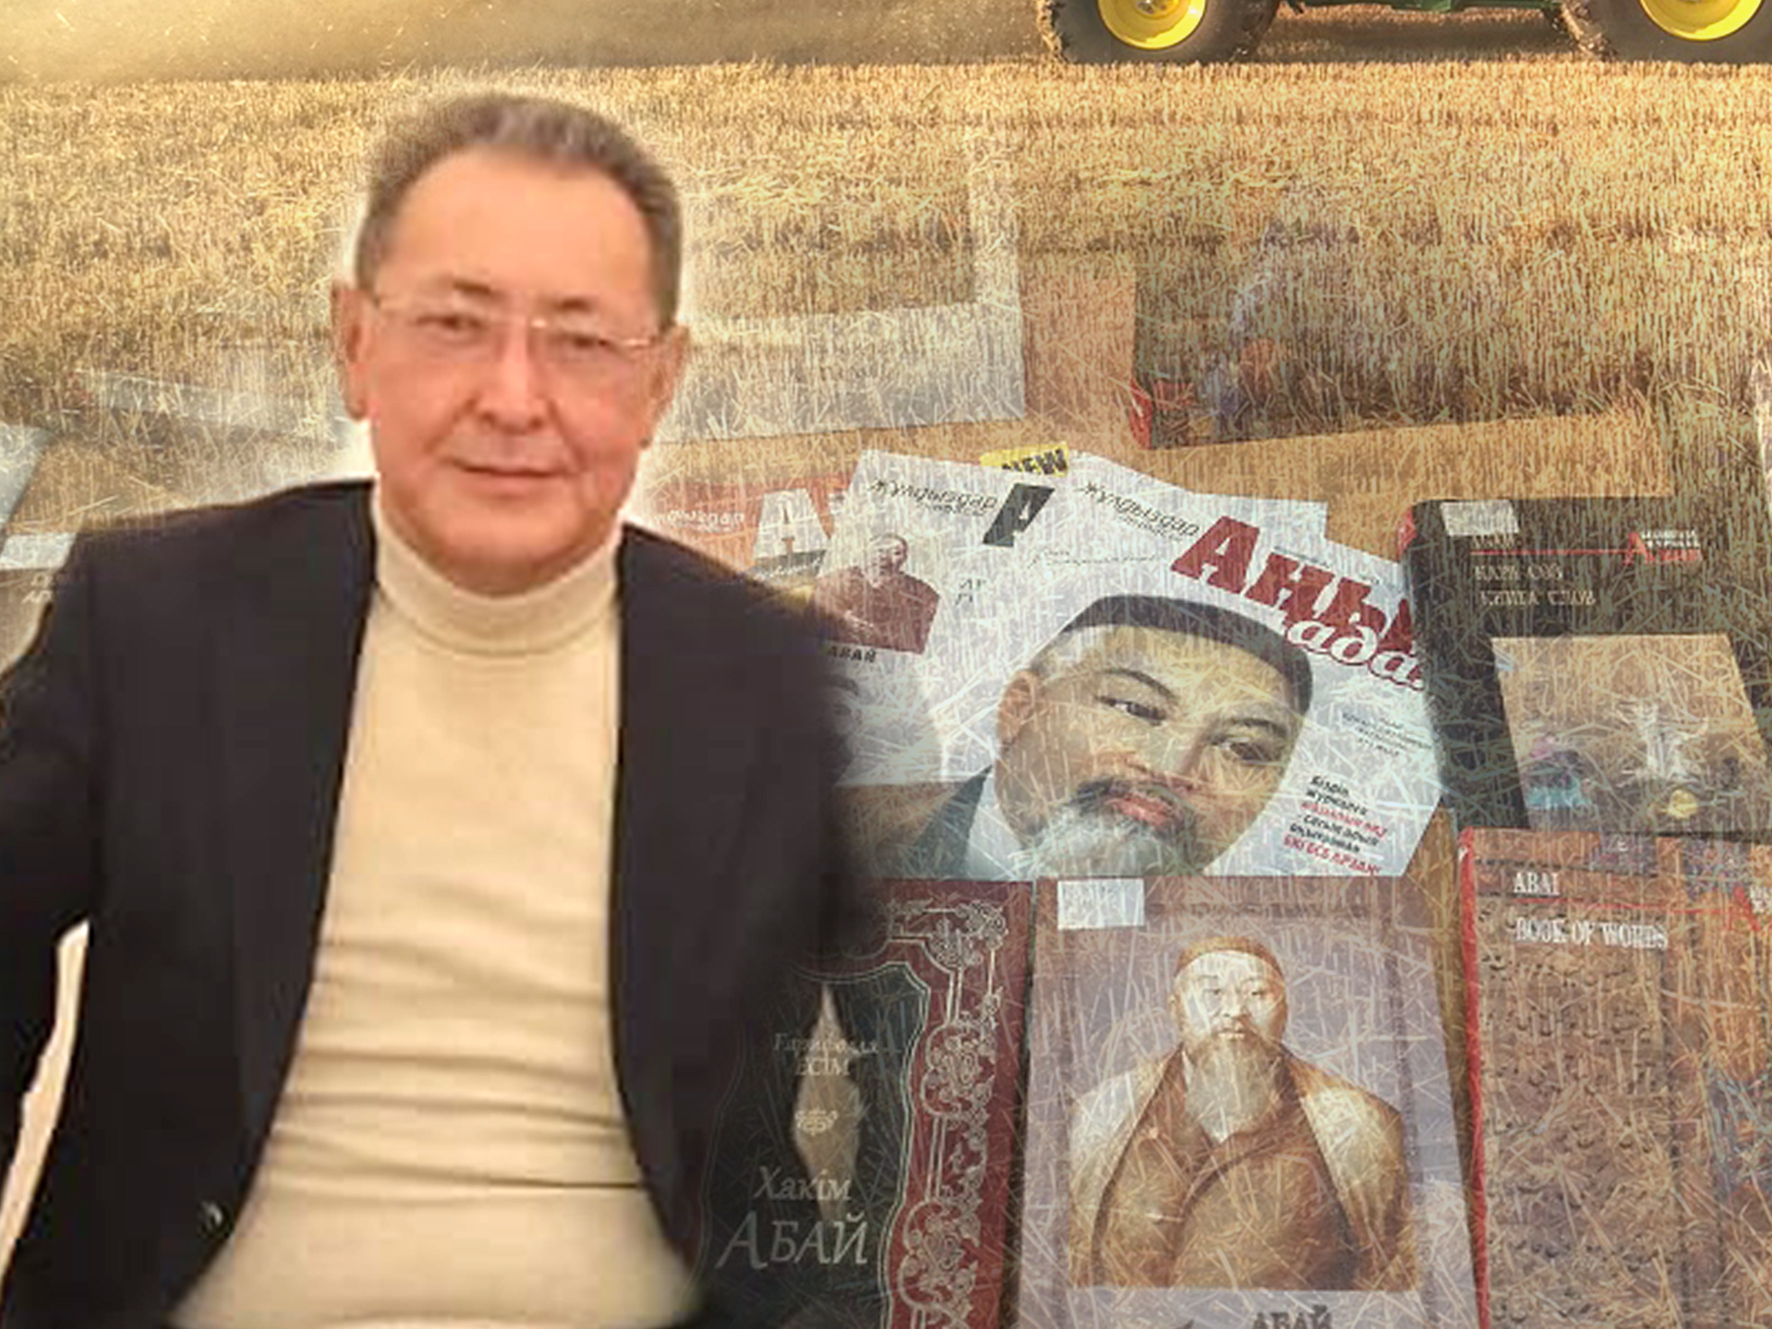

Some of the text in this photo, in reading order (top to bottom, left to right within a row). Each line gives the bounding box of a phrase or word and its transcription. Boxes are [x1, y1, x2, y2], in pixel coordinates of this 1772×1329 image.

[1513, 871, 1561, 896] ABAI
[1515, 917, 1568, 944] BOOK
[1600, 922, 1669, 950] WORDS
[752, 1165, 854, 1202] Хакім
[714, 1209, 870, 1270] АБАЙ
